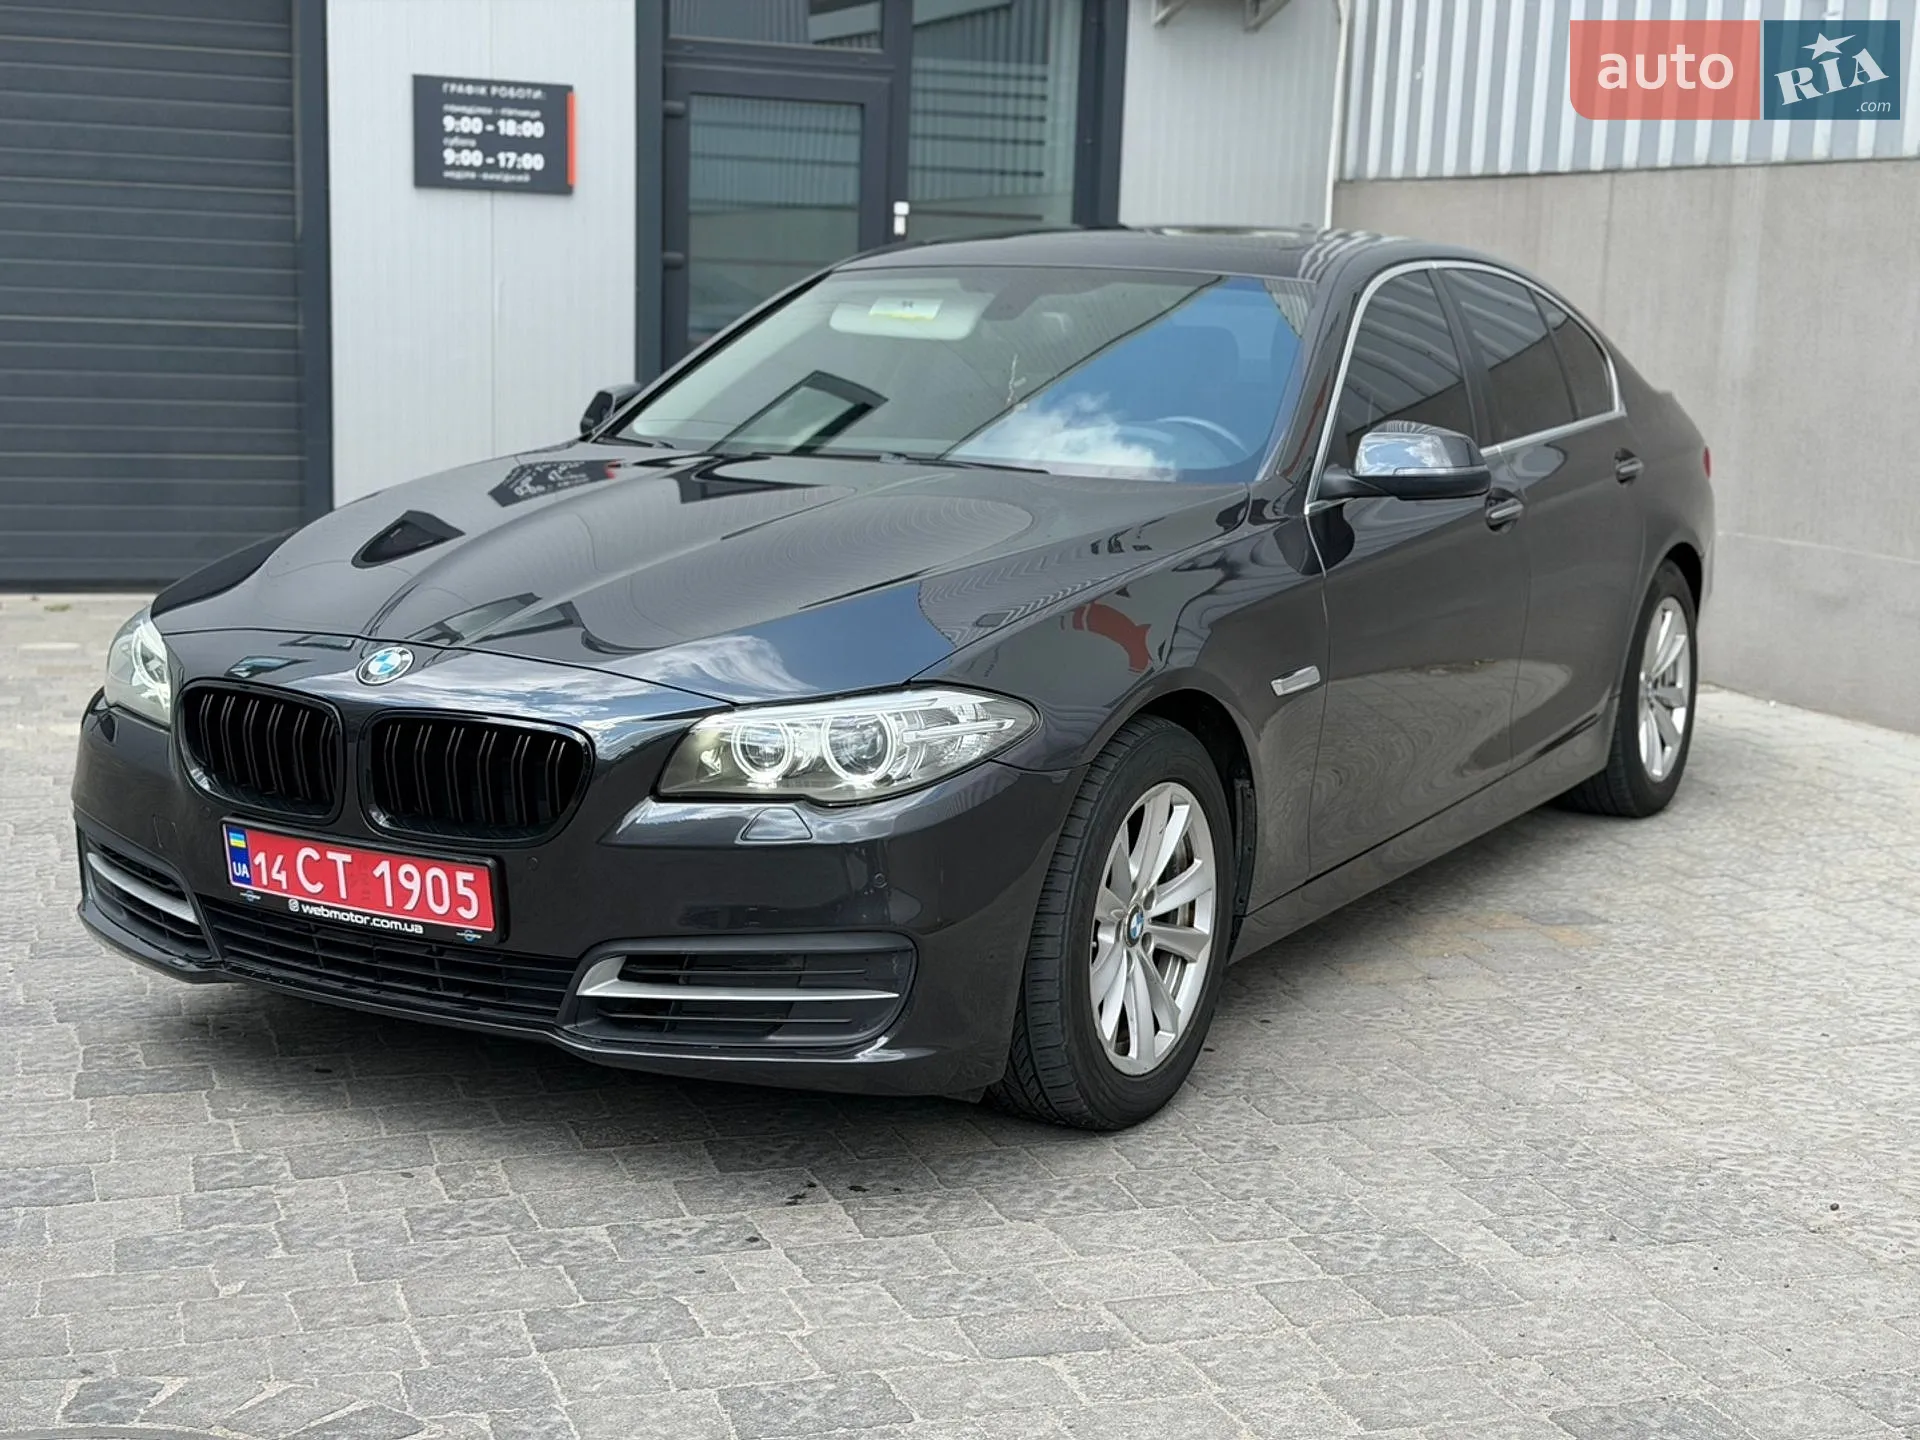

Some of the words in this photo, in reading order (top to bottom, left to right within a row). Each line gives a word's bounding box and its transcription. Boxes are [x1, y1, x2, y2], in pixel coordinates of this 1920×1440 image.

[442, 82, 488, 96] ГРАФІК
[442, 115, 483, 134] 9:00
[497, 118, 545, 138] 18:00
[442, 148, 483, 167] 9:00
[497, 151, 545, 171] 17:00
[232, 861, 251, 879] UA
[253, 851, 288, 890] 14
[296, 846, 352, 900] CT
[372, 859, 480, 920] 1905
[301, 903, 424, 935] webmotor.com.ua
